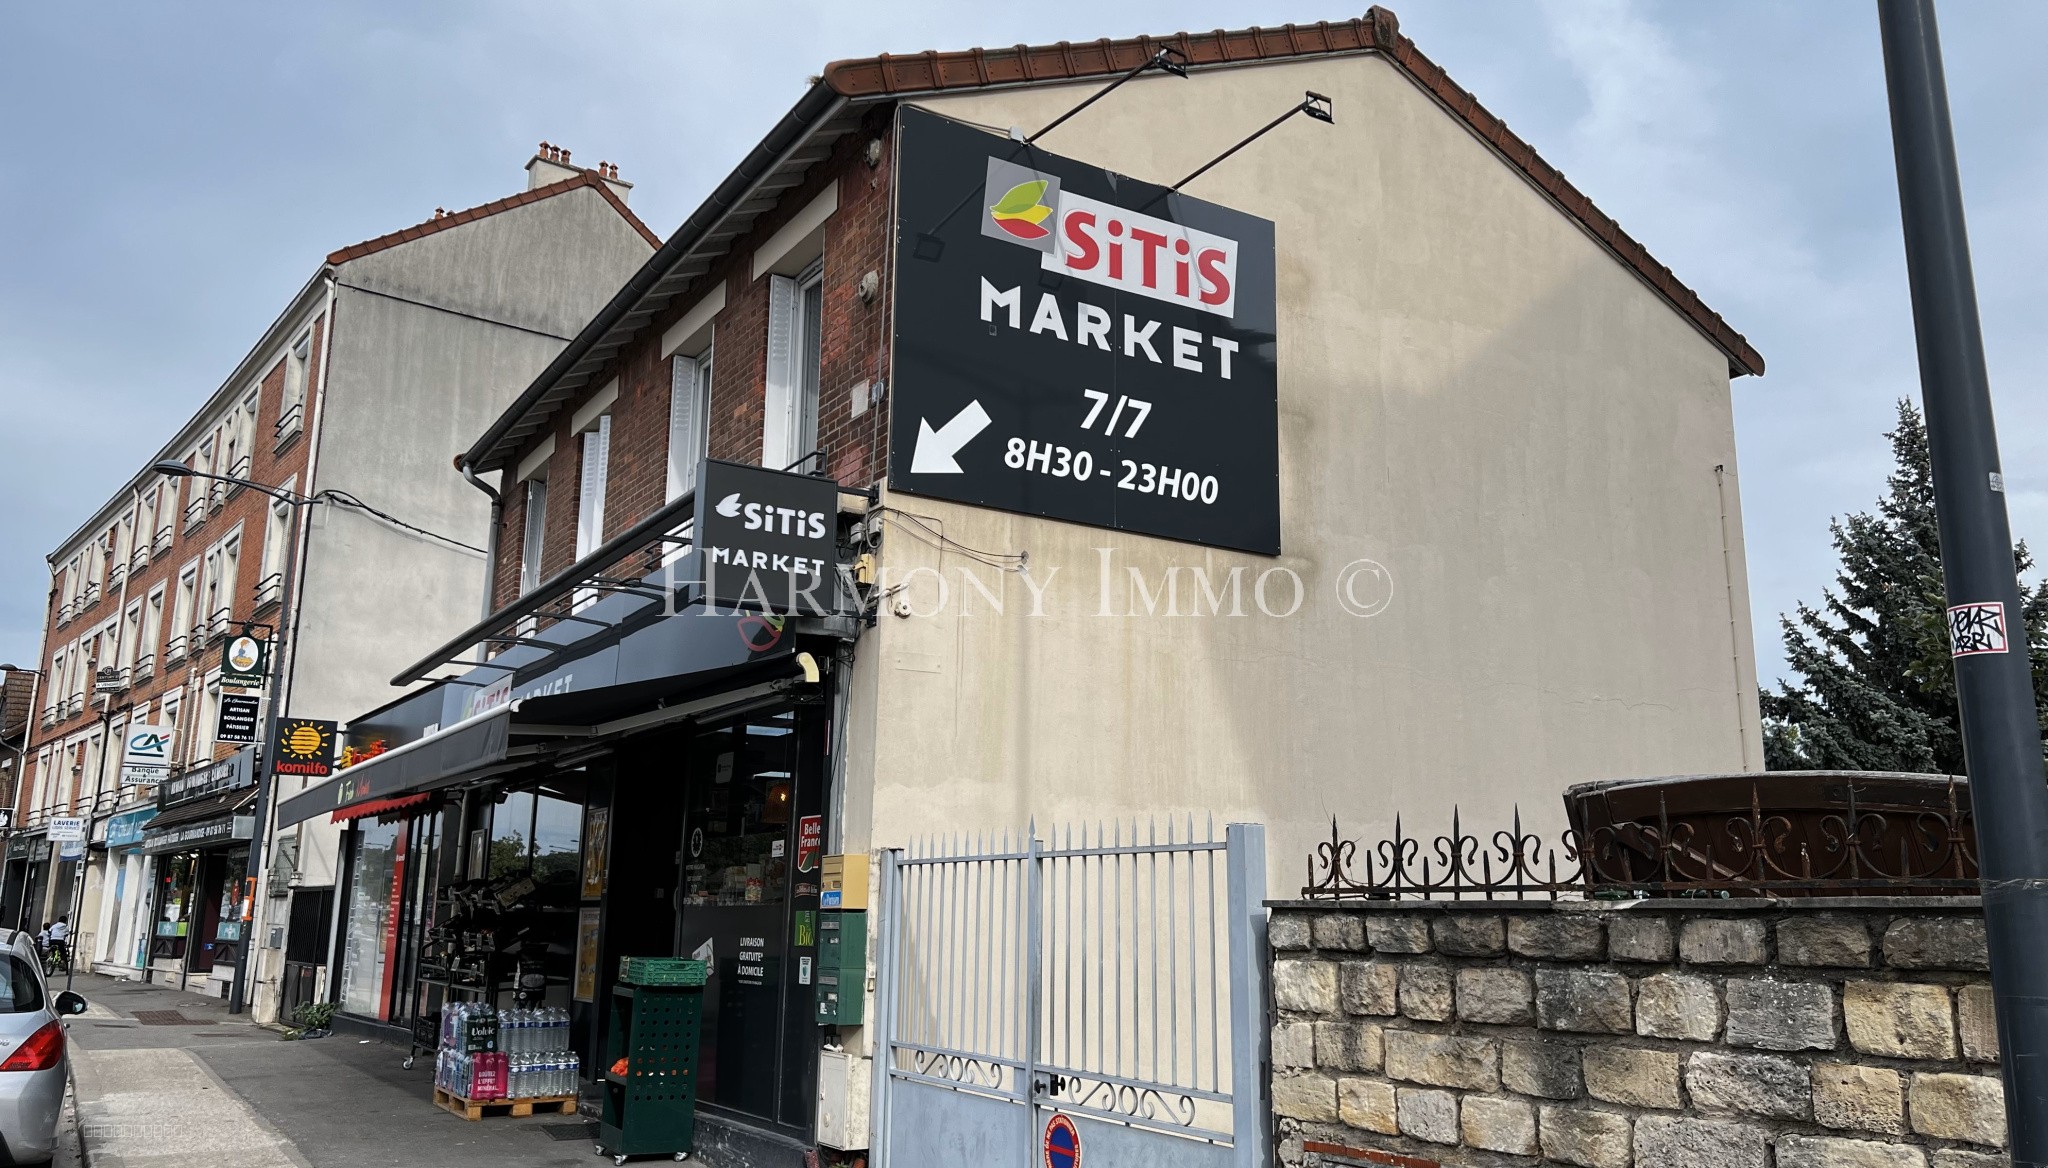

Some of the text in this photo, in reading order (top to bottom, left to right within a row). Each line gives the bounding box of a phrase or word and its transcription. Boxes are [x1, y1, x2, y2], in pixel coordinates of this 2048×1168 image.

[980, 275, 1239, 379] MARKET
[1080, 388, 1152, 439] 7/7
[1003, 437, 1093, 481] 8H30
[1117, 460, 1219, 504] 23H00
[712, 545, 825, 577] MARKET
[221, 676, 260, 686] Boulangerie
[131, 767, 159, 775] Banque
[276, 761, 327, 775] komilfo
[125, 776, 162, 784] Assuranc
[804, 822, 821, 835] Belle
[740, 938, 764, 947] LIVRAISON
[742, 966, 763, 976] DOMICILE
[472, 1027, 495, 1037] Volvic
